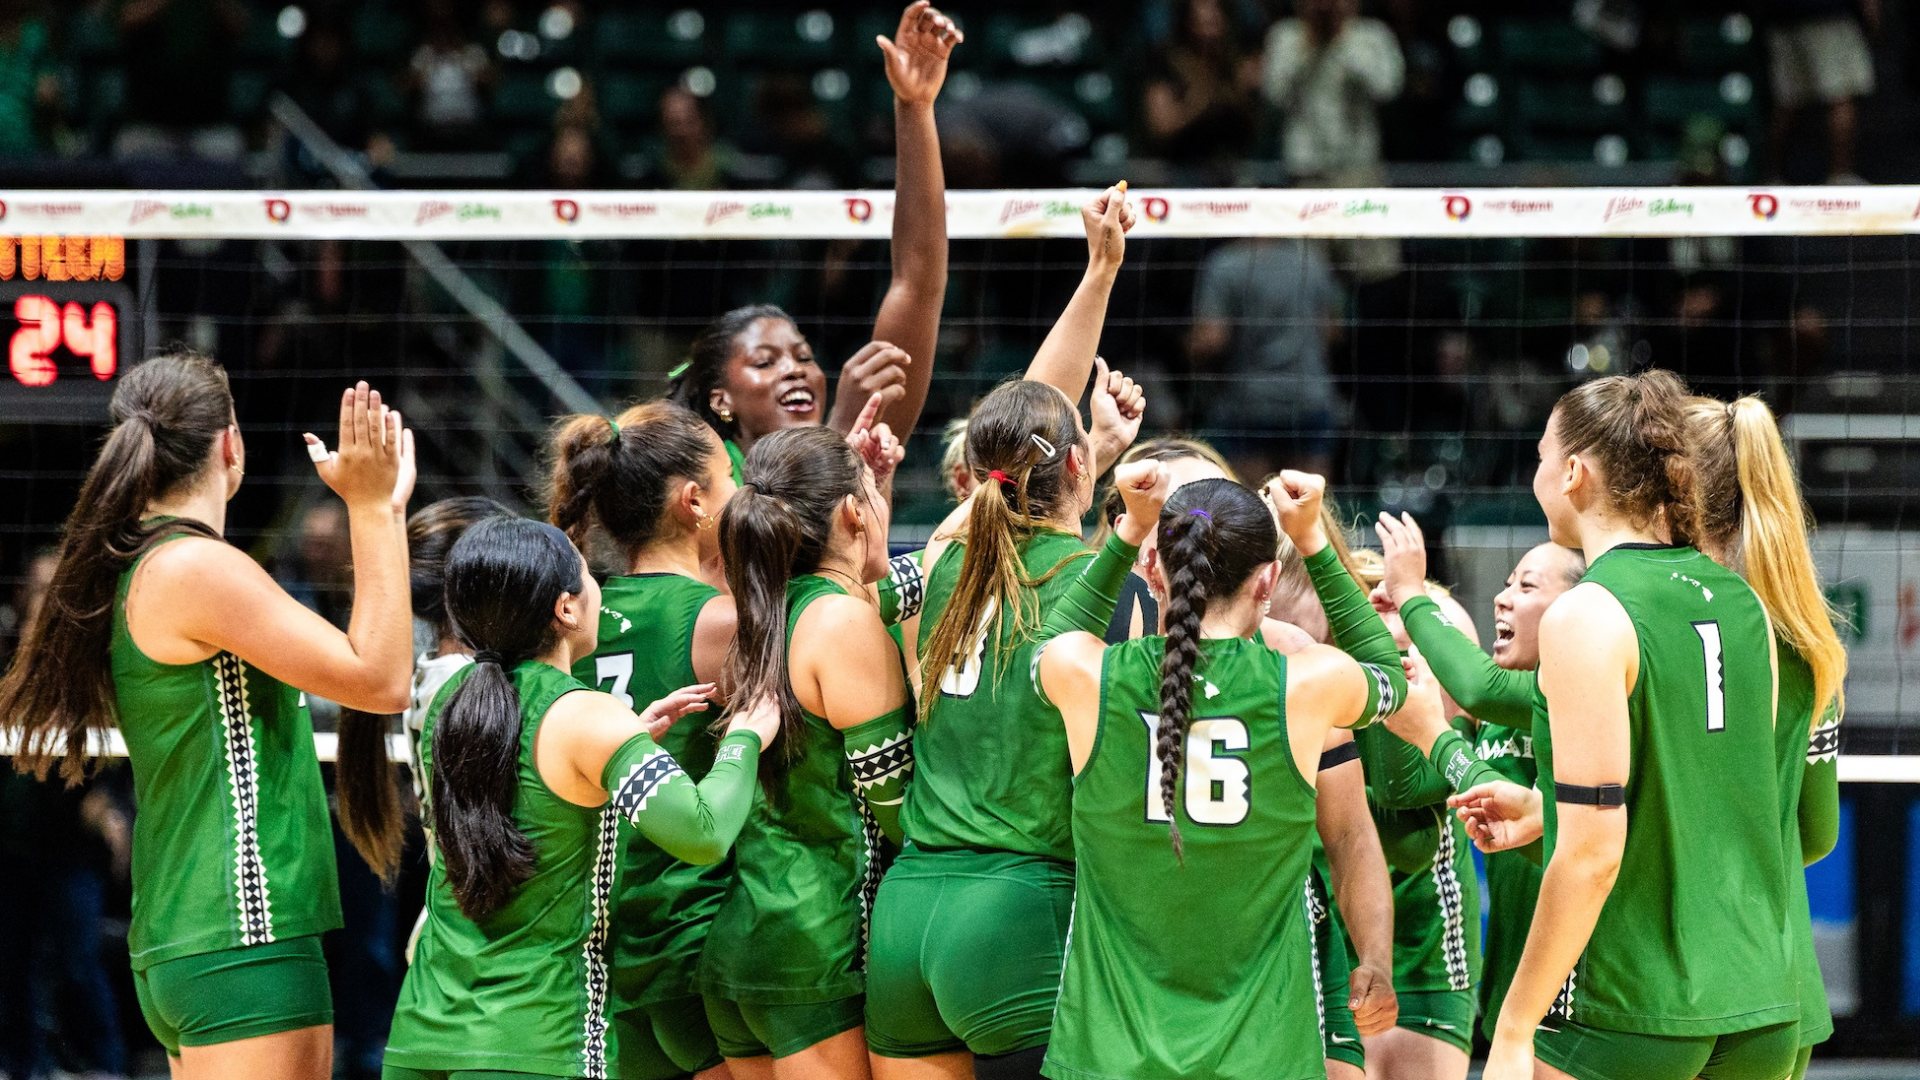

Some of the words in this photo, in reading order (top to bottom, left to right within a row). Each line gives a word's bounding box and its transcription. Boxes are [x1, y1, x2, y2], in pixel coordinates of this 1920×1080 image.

[9, 294, 117, 387] 24
[1689, 620, 1725, 733] 1
[1135, 708, 1251, 828] 16
